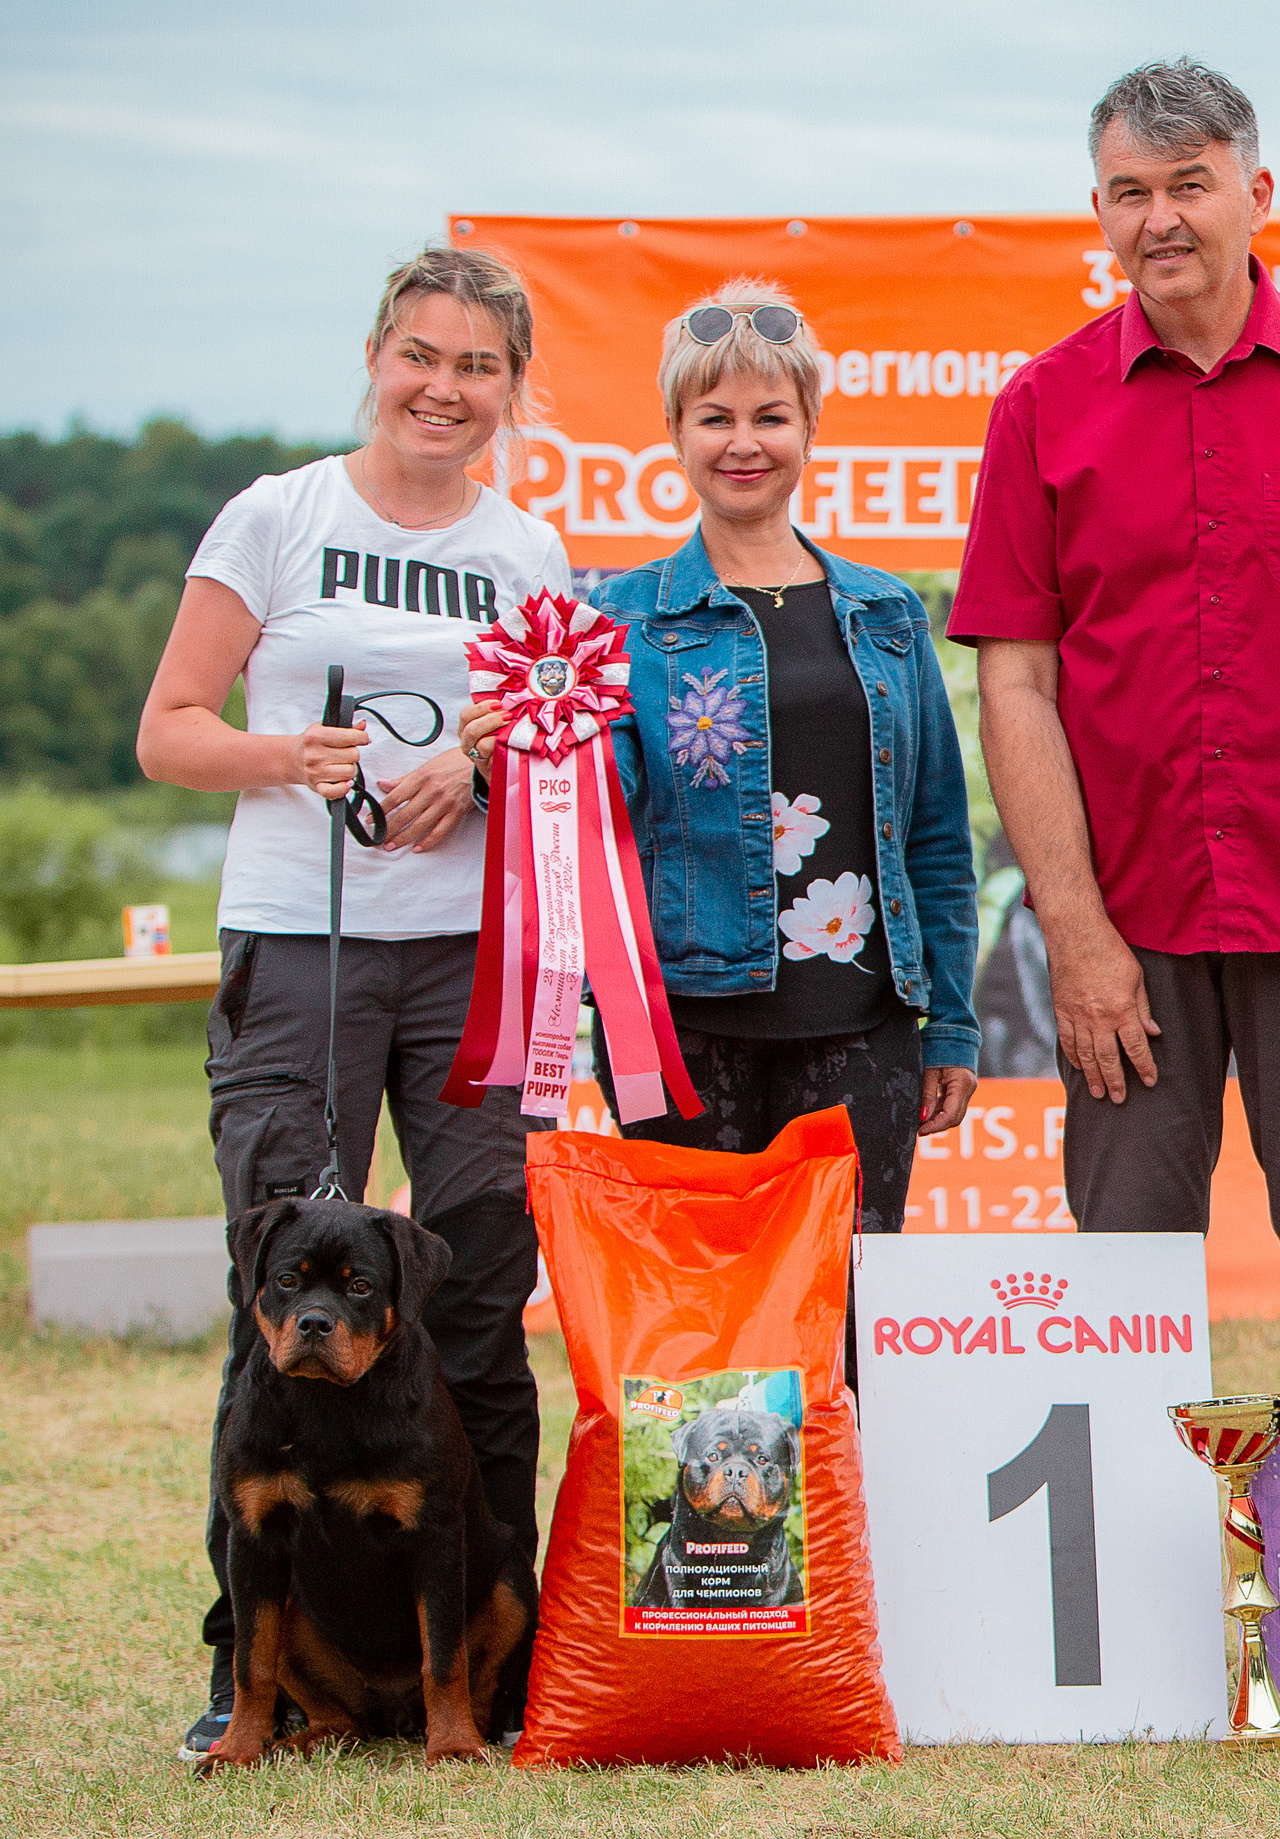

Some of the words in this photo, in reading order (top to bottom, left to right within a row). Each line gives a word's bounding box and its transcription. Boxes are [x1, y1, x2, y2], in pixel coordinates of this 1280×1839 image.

[1081, 249, 1133, 309] 3-
[816, 350, 1036, 397] егион
[320, 547, 500, 624] PUMA
[539, 779, 571, 796] РКФ
[533, 1061, 565, 1079] BEST
[526, 1080, 567, 1100] PUPPY
[873, 1315, 1026, 1356] ROYAL
[1036, 1314, 1194, 1355] CANIN
[986, 1402, 1102, 1687] 1
[665, 1563, 769, 1576] ПОЛНОРАЦИОННЫЙ
[701, 1577, 731, 1587] КОРМ
[672, 1589, 694, 1599] ДЛЯ
[696, 1588, 762, 1598] ЧЕМПИОНОВ
[641, 1610, 748, 1621] ПРОФЕССИОНАЛЬНЫЙ
[749, 1609, 789, 1619] ПОДХОД
[634, 1622, 641, 1631] К
[642, 1622, 704, 1632] КОРМЛЕНИЮ
[705, 1622, 741, 1631] ВАШИХ
[742, 1620, 796, 1631] ПИТОМЦЕВ!
